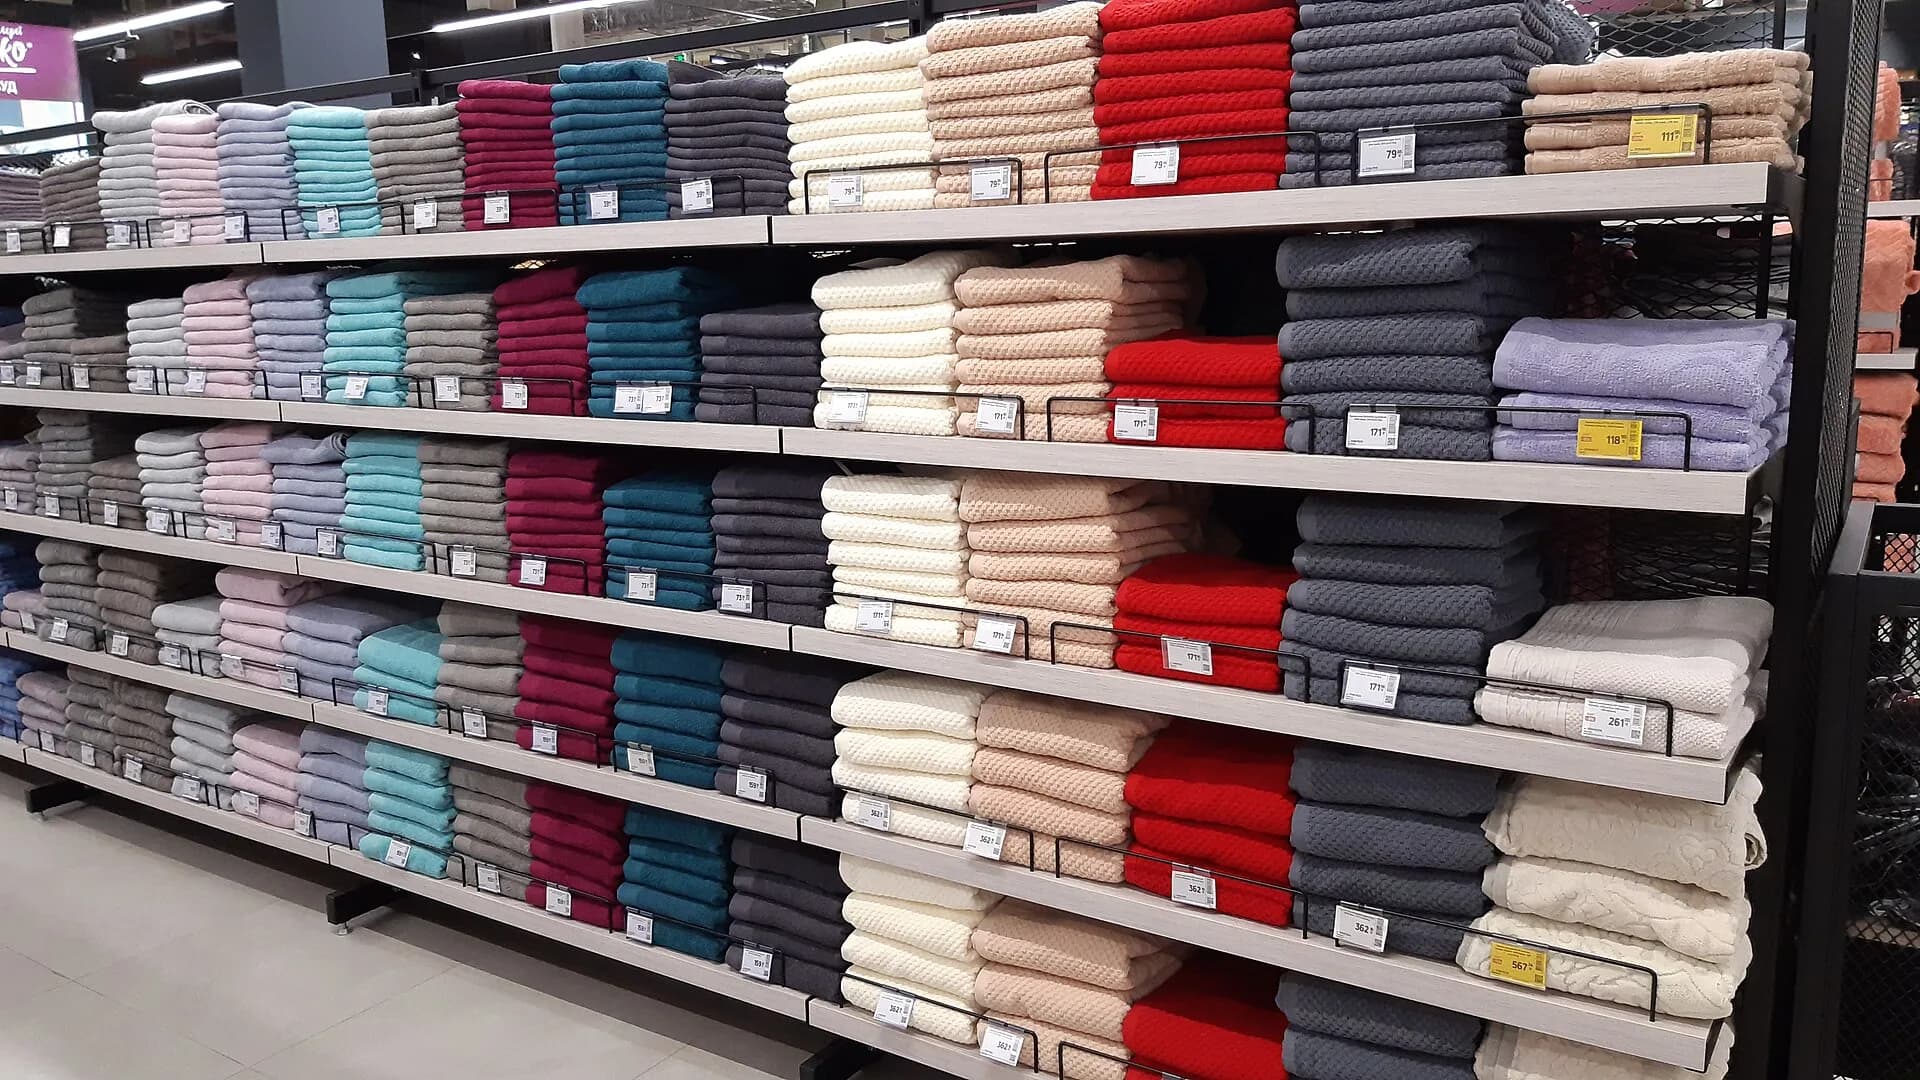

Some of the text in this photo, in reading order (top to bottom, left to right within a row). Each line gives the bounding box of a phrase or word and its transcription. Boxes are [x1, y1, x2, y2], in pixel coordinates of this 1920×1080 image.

[1662, 131, 1674, 141] 111
[1607, 435, 1621, 444] 118
[1608, 717, 1624, 727] 261
[1188, 884, 1201, 894] 362
[1355, 922, 1369, 934] 362
[1512, 960, 1528, 971] 567
